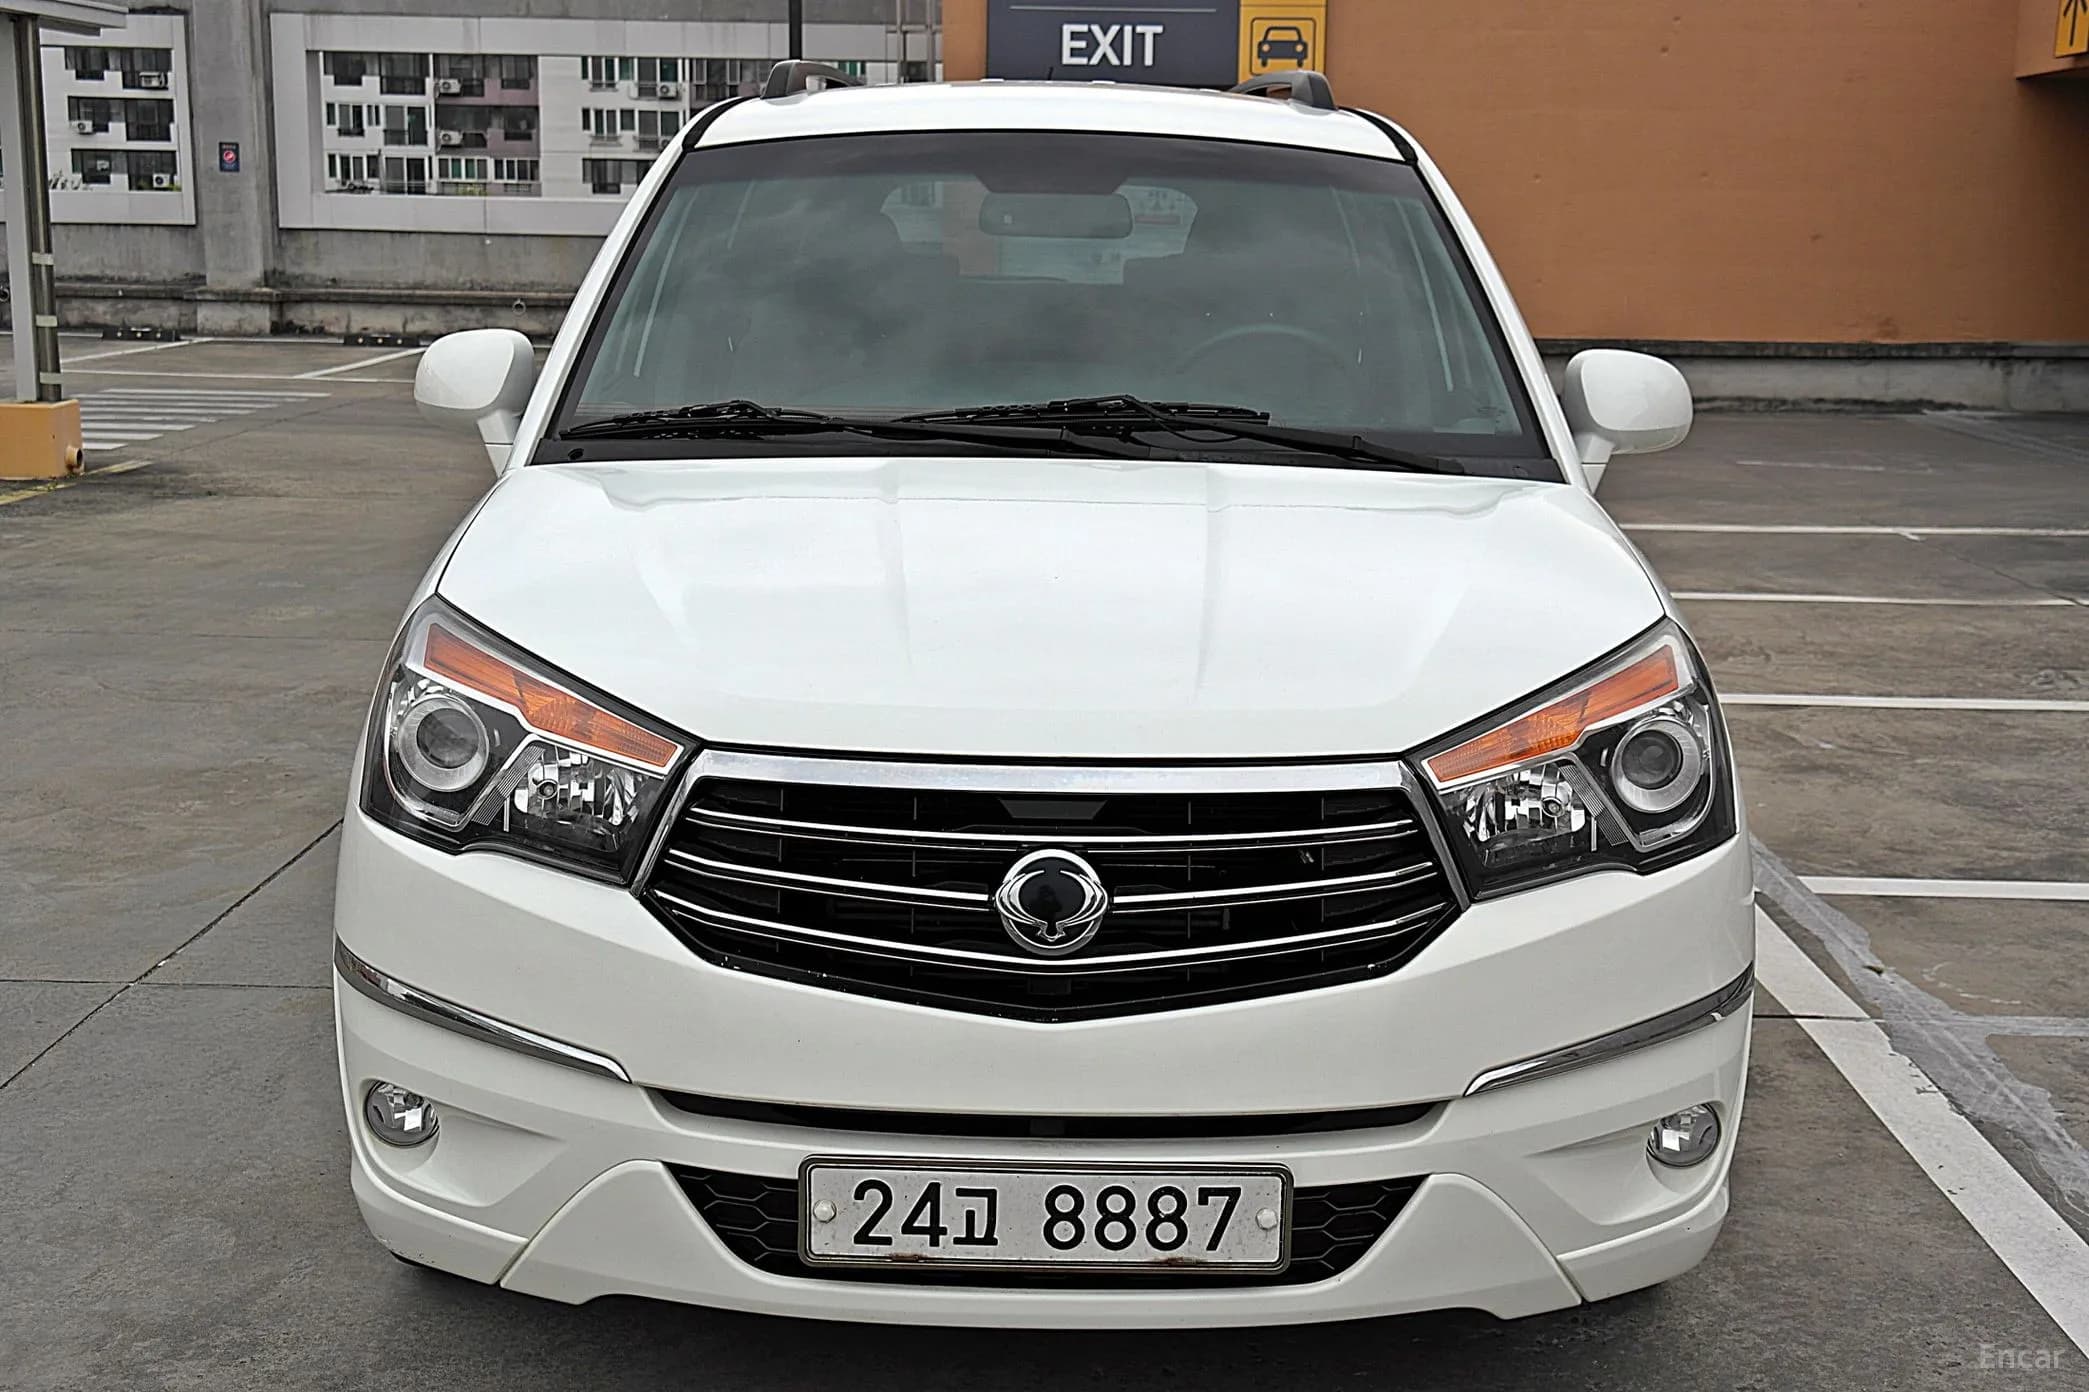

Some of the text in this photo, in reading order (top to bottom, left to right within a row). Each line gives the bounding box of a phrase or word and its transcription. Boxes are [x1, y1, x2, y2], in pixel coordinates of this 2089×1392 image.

[1061, 24, 1164, 66] EXIT
[853, 1179, 1243, 1252] 24고 8887
